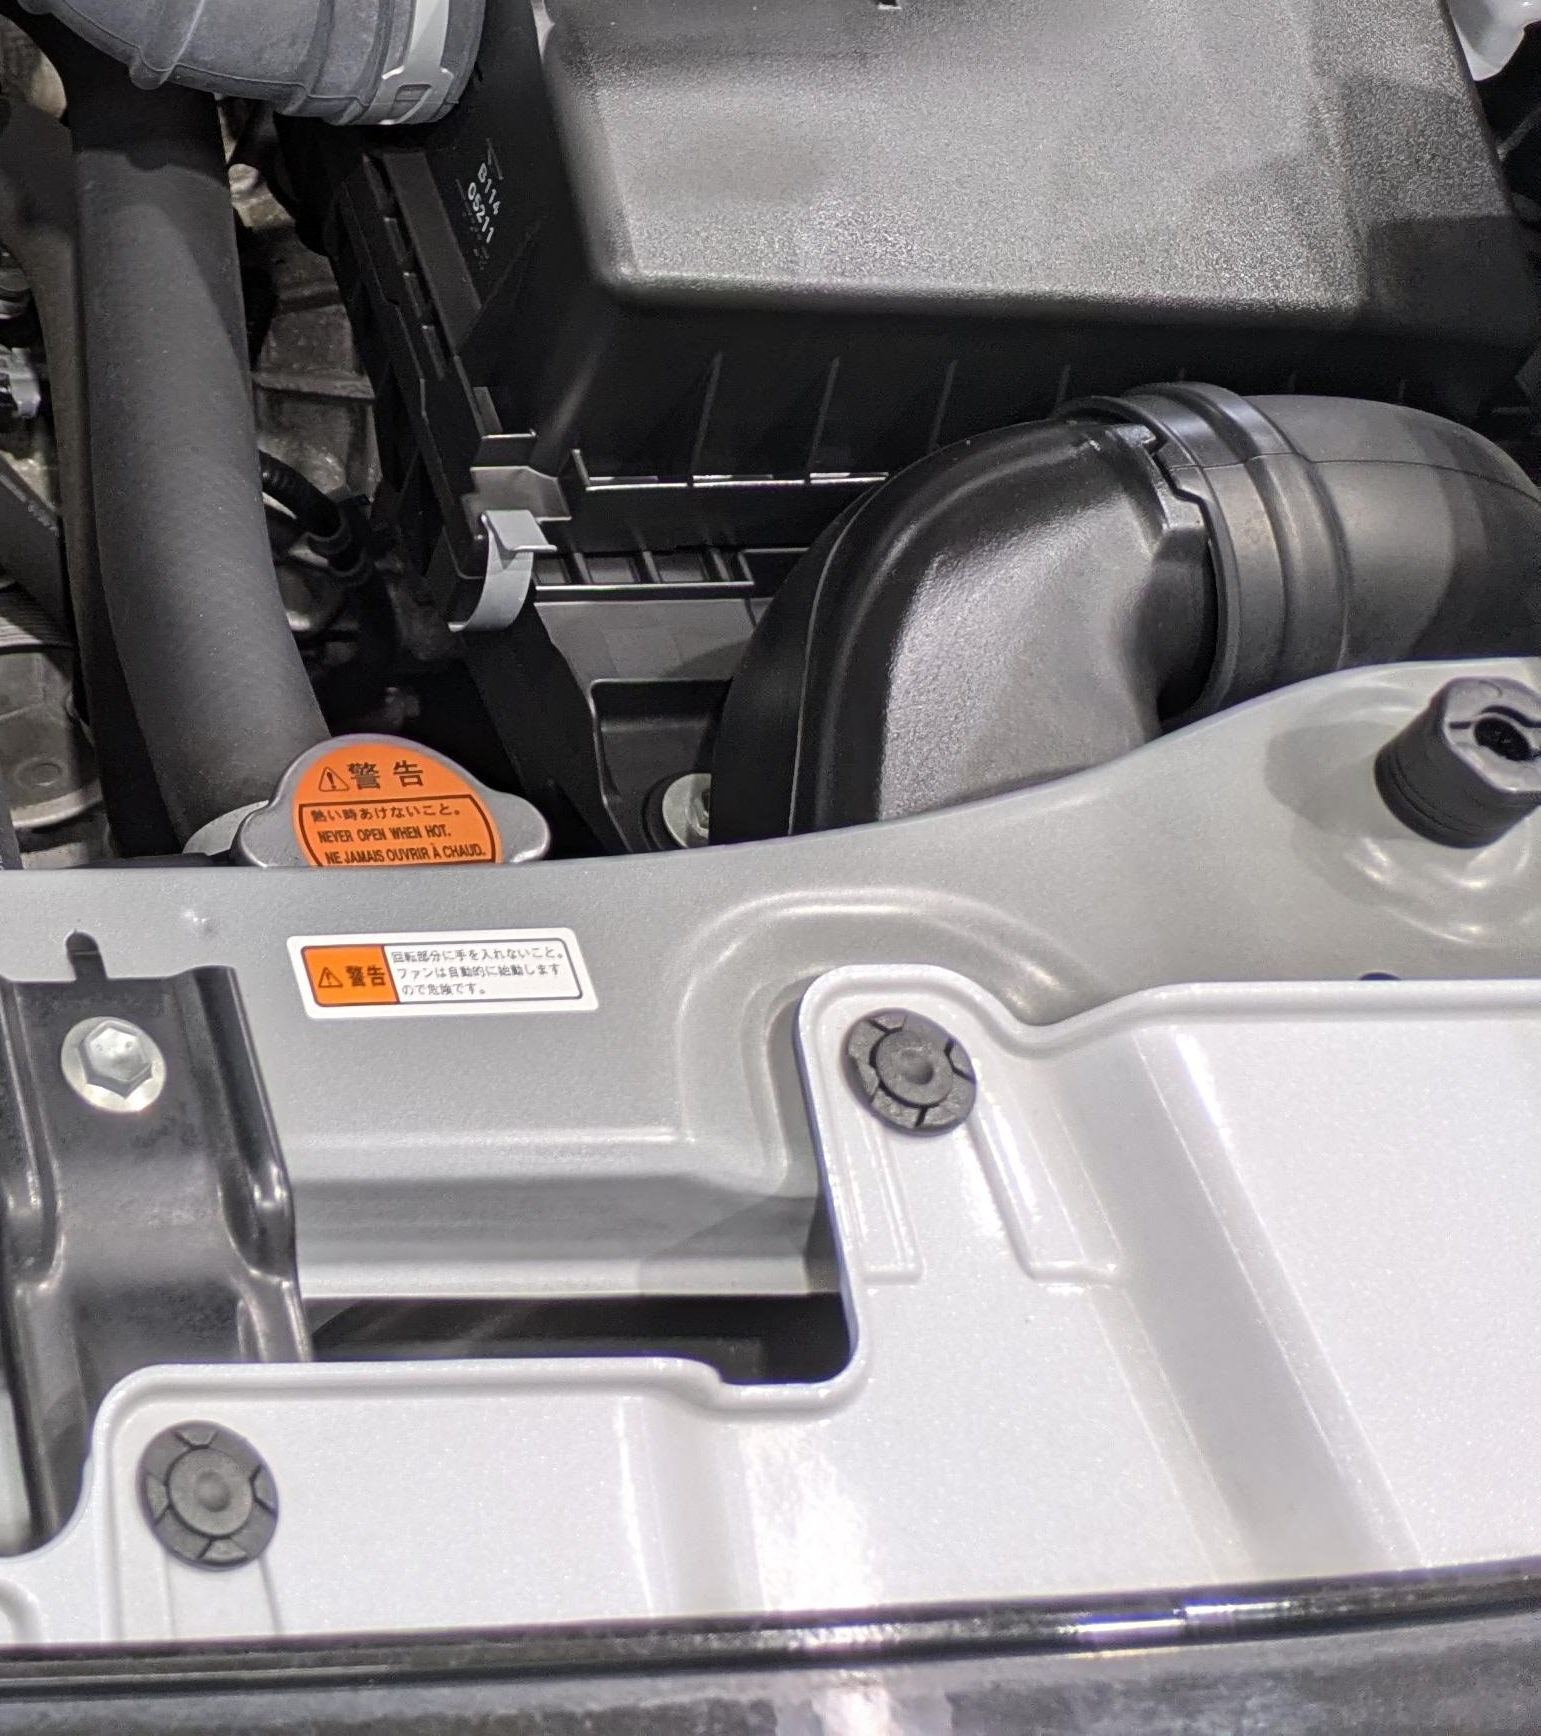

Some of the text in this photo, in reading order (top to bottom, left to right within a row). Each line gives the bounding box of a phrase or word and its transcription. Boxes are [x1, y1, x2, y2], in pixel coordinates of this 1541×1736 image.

[317, 823, 452, 844] NEVER OPEN WHEN HOT.
[324, 842, 487, 865] NE JAMAIS OUVRIR À CHAUD.
[345, 964, 387, 988] 警告
